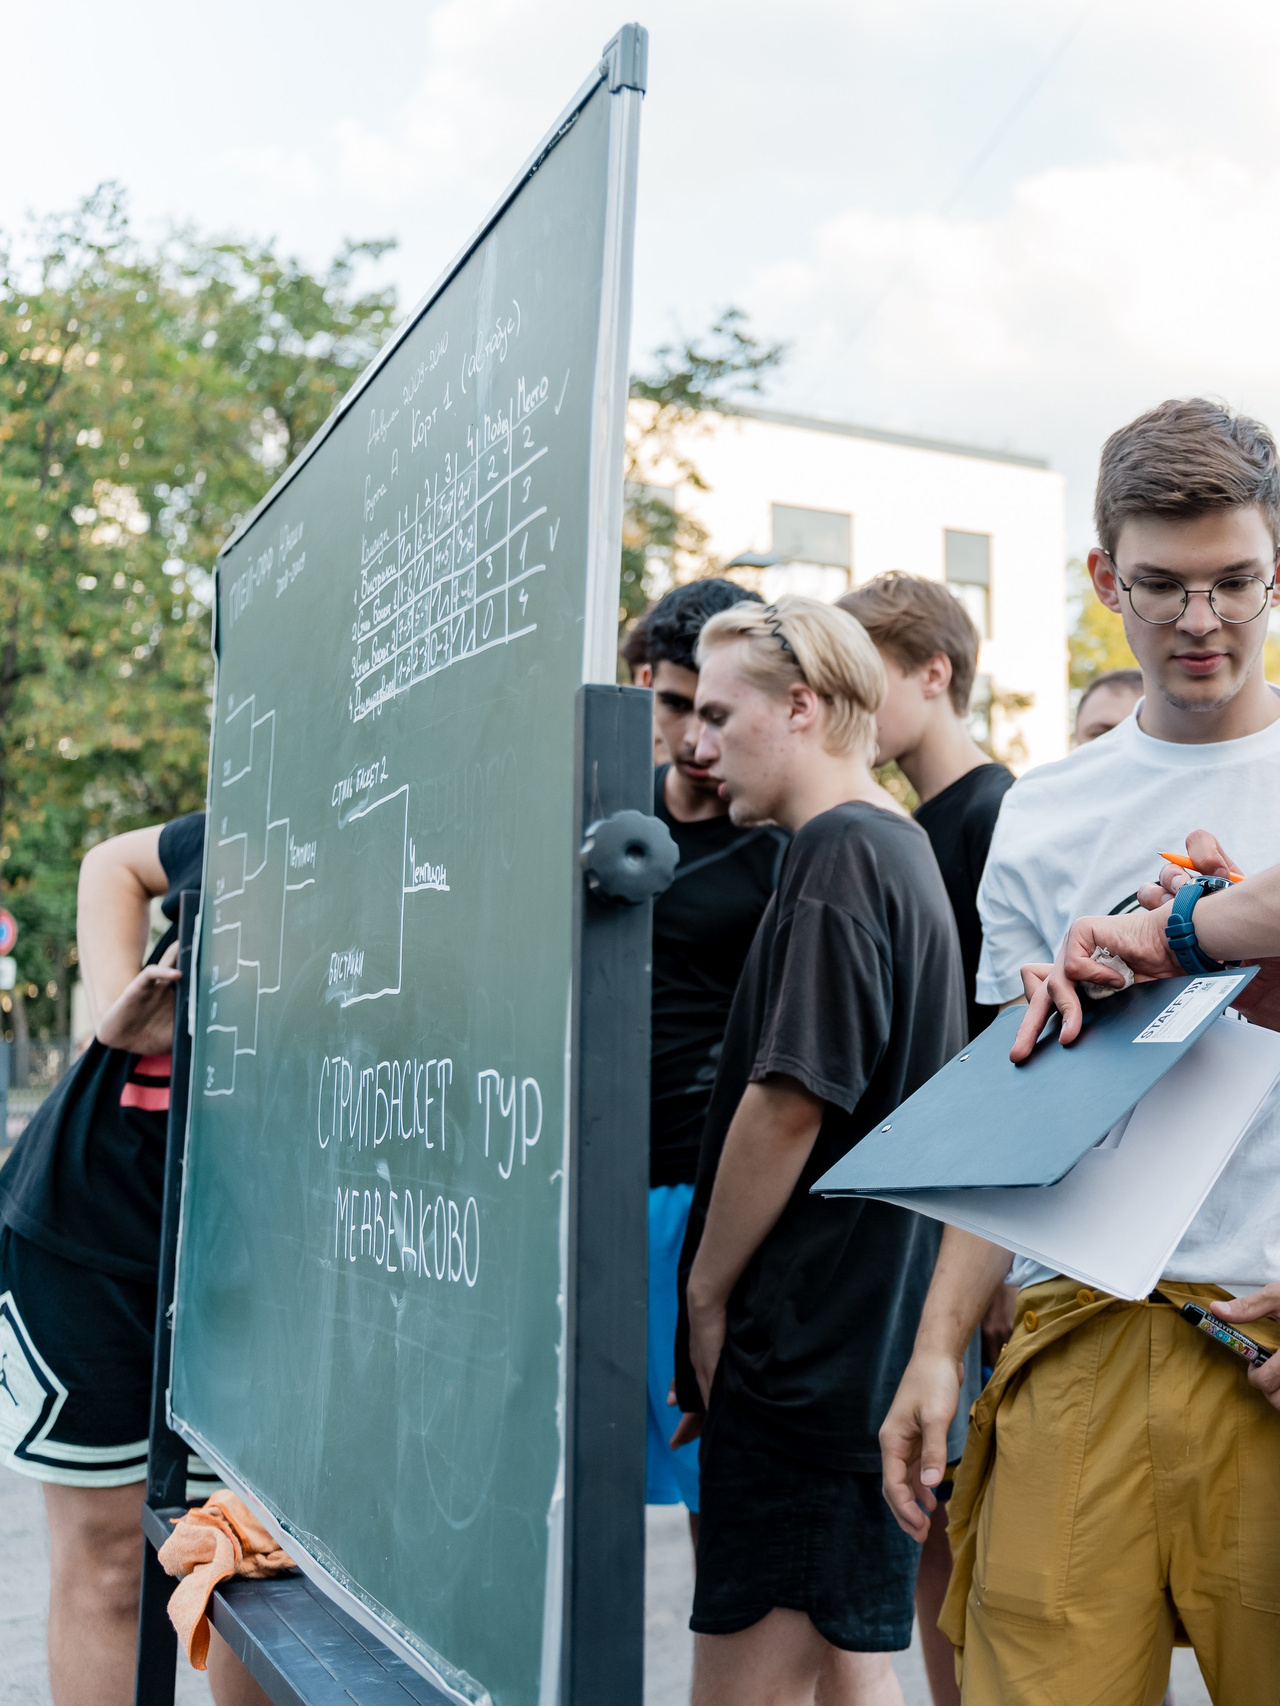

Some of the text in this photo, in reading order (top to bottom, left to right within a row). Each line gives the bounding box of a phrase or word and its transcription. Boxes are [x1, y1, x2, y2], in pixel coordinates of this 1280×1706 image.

[411, 406, 438, 453] Корт
[424, 478, 432, 507] 2
[444, 452, 452, 483] 3
[466, 424, 474, 457] 4
[517, 375, 549, 419] Место
[487, 454, 499, 481] 2
[522, 425, 535, 449] 2
[522, 475, 532, 504] 3
[485, 554, 494, 579] 3
[482, 598, 494, 640] 0
[518, 587, 529, 617] 4
[380, 755, 389, 784] 2
[1141, 998, 1183, 1039] STAFF
[317, 1056, 543, 1180] СТРИТБАСКЕТ ТУР
